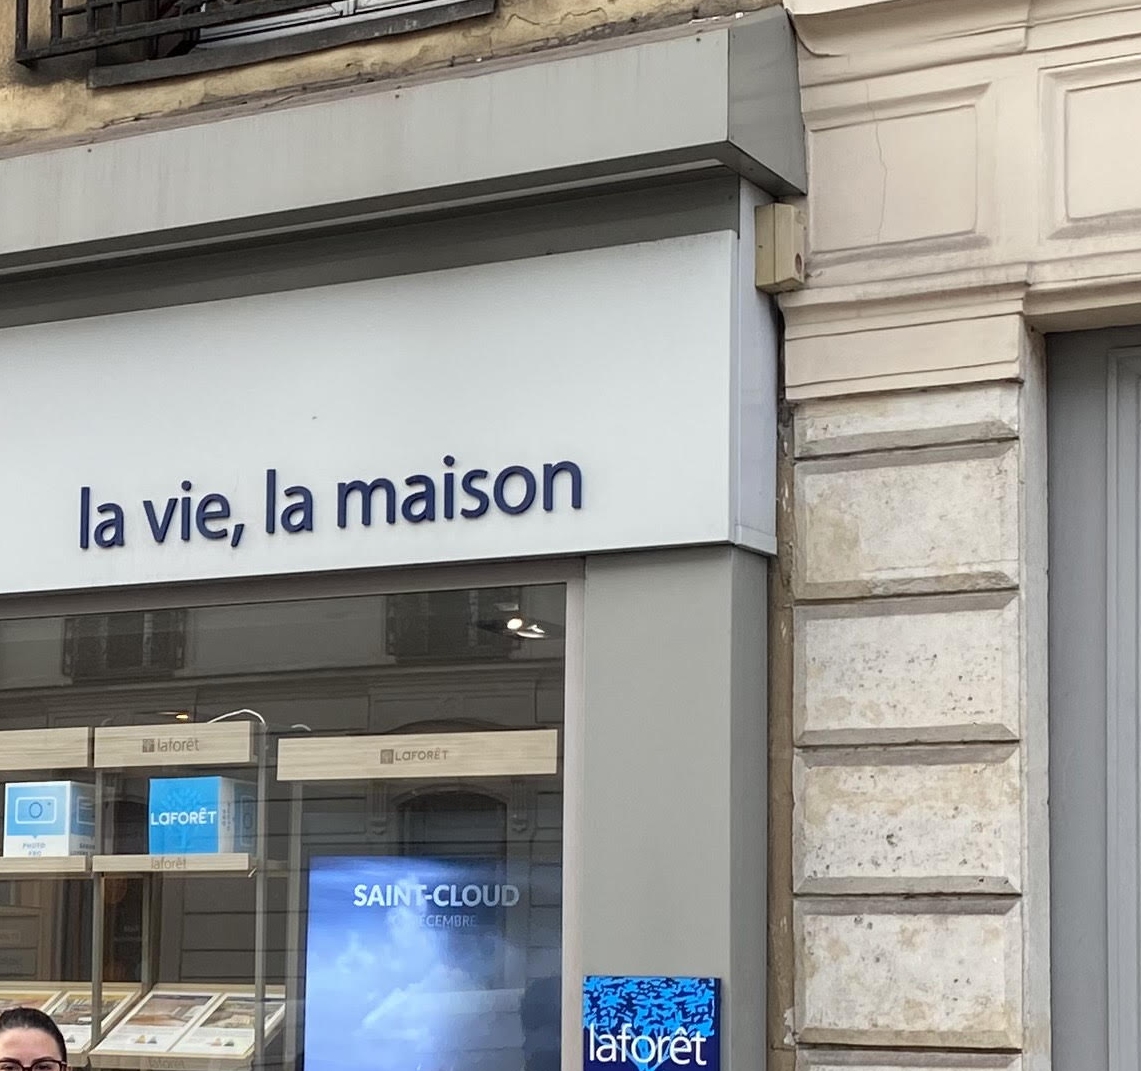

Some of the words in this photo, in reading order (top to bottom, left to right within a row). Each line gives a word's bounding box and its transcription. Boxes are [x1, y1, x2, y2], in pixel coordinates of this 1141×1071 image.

[80, 486, 125, 549] la
[143, 480, 245, 547] vie,
[265, 468, 313, 535] la
[337, 454, 582, 528] maison
[157, 737, 200, 752] laforêt
[353, 884, 520, 907] SAINT-CLOUD
[588, 1022, 707, 1067] laforêt
